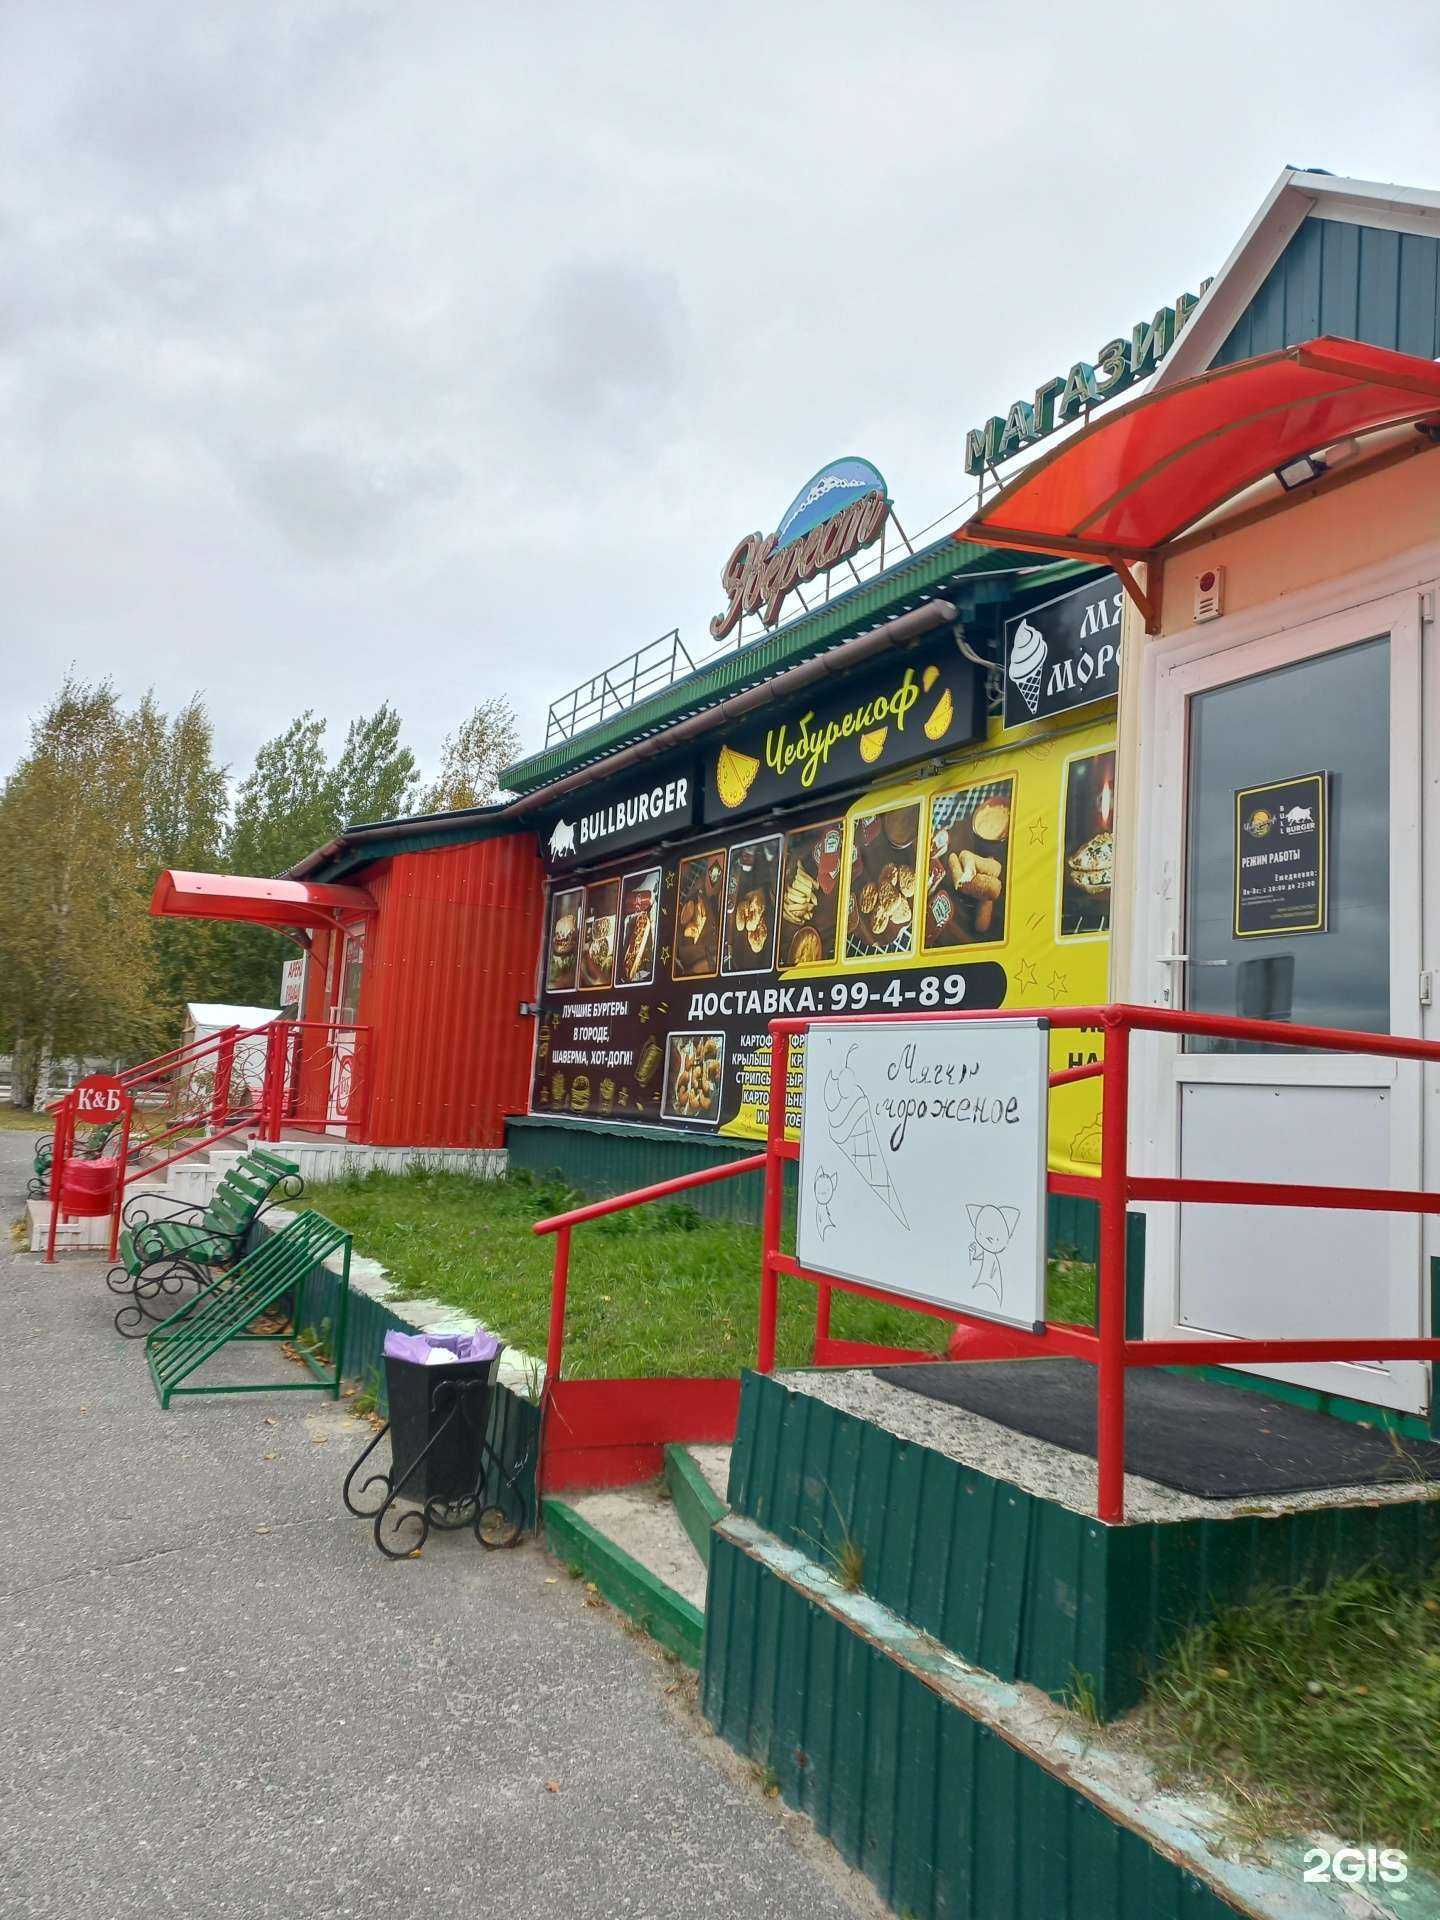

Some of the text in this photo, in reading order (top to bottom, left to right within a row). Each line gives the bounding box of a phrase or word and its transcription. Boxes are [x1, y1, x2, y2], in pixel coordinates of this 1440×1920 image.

[579, 777, 689, 844] BULLBURGER
[1286, 822, 1316, 834] BURGER
[1241, 848, 1301, 869] РЕЖИМ РАБОТЫ
[687, 974, 966, 1021] ДОСТАВКА: 99-4-89
[561, 1000, 629, 1018] ЛУЧШИЕ БУРГЕРЫ
[572, 1026, 610, 1044] В ГОРОДЕ,
[740, 1034, 773, 1047] КАРТОФ
[552, 1050, 633, 1068] ШАВЕРМА, ХОТ-ДОГИ!
[731, 1053, 772, 1066] КРЫЛЫШ
